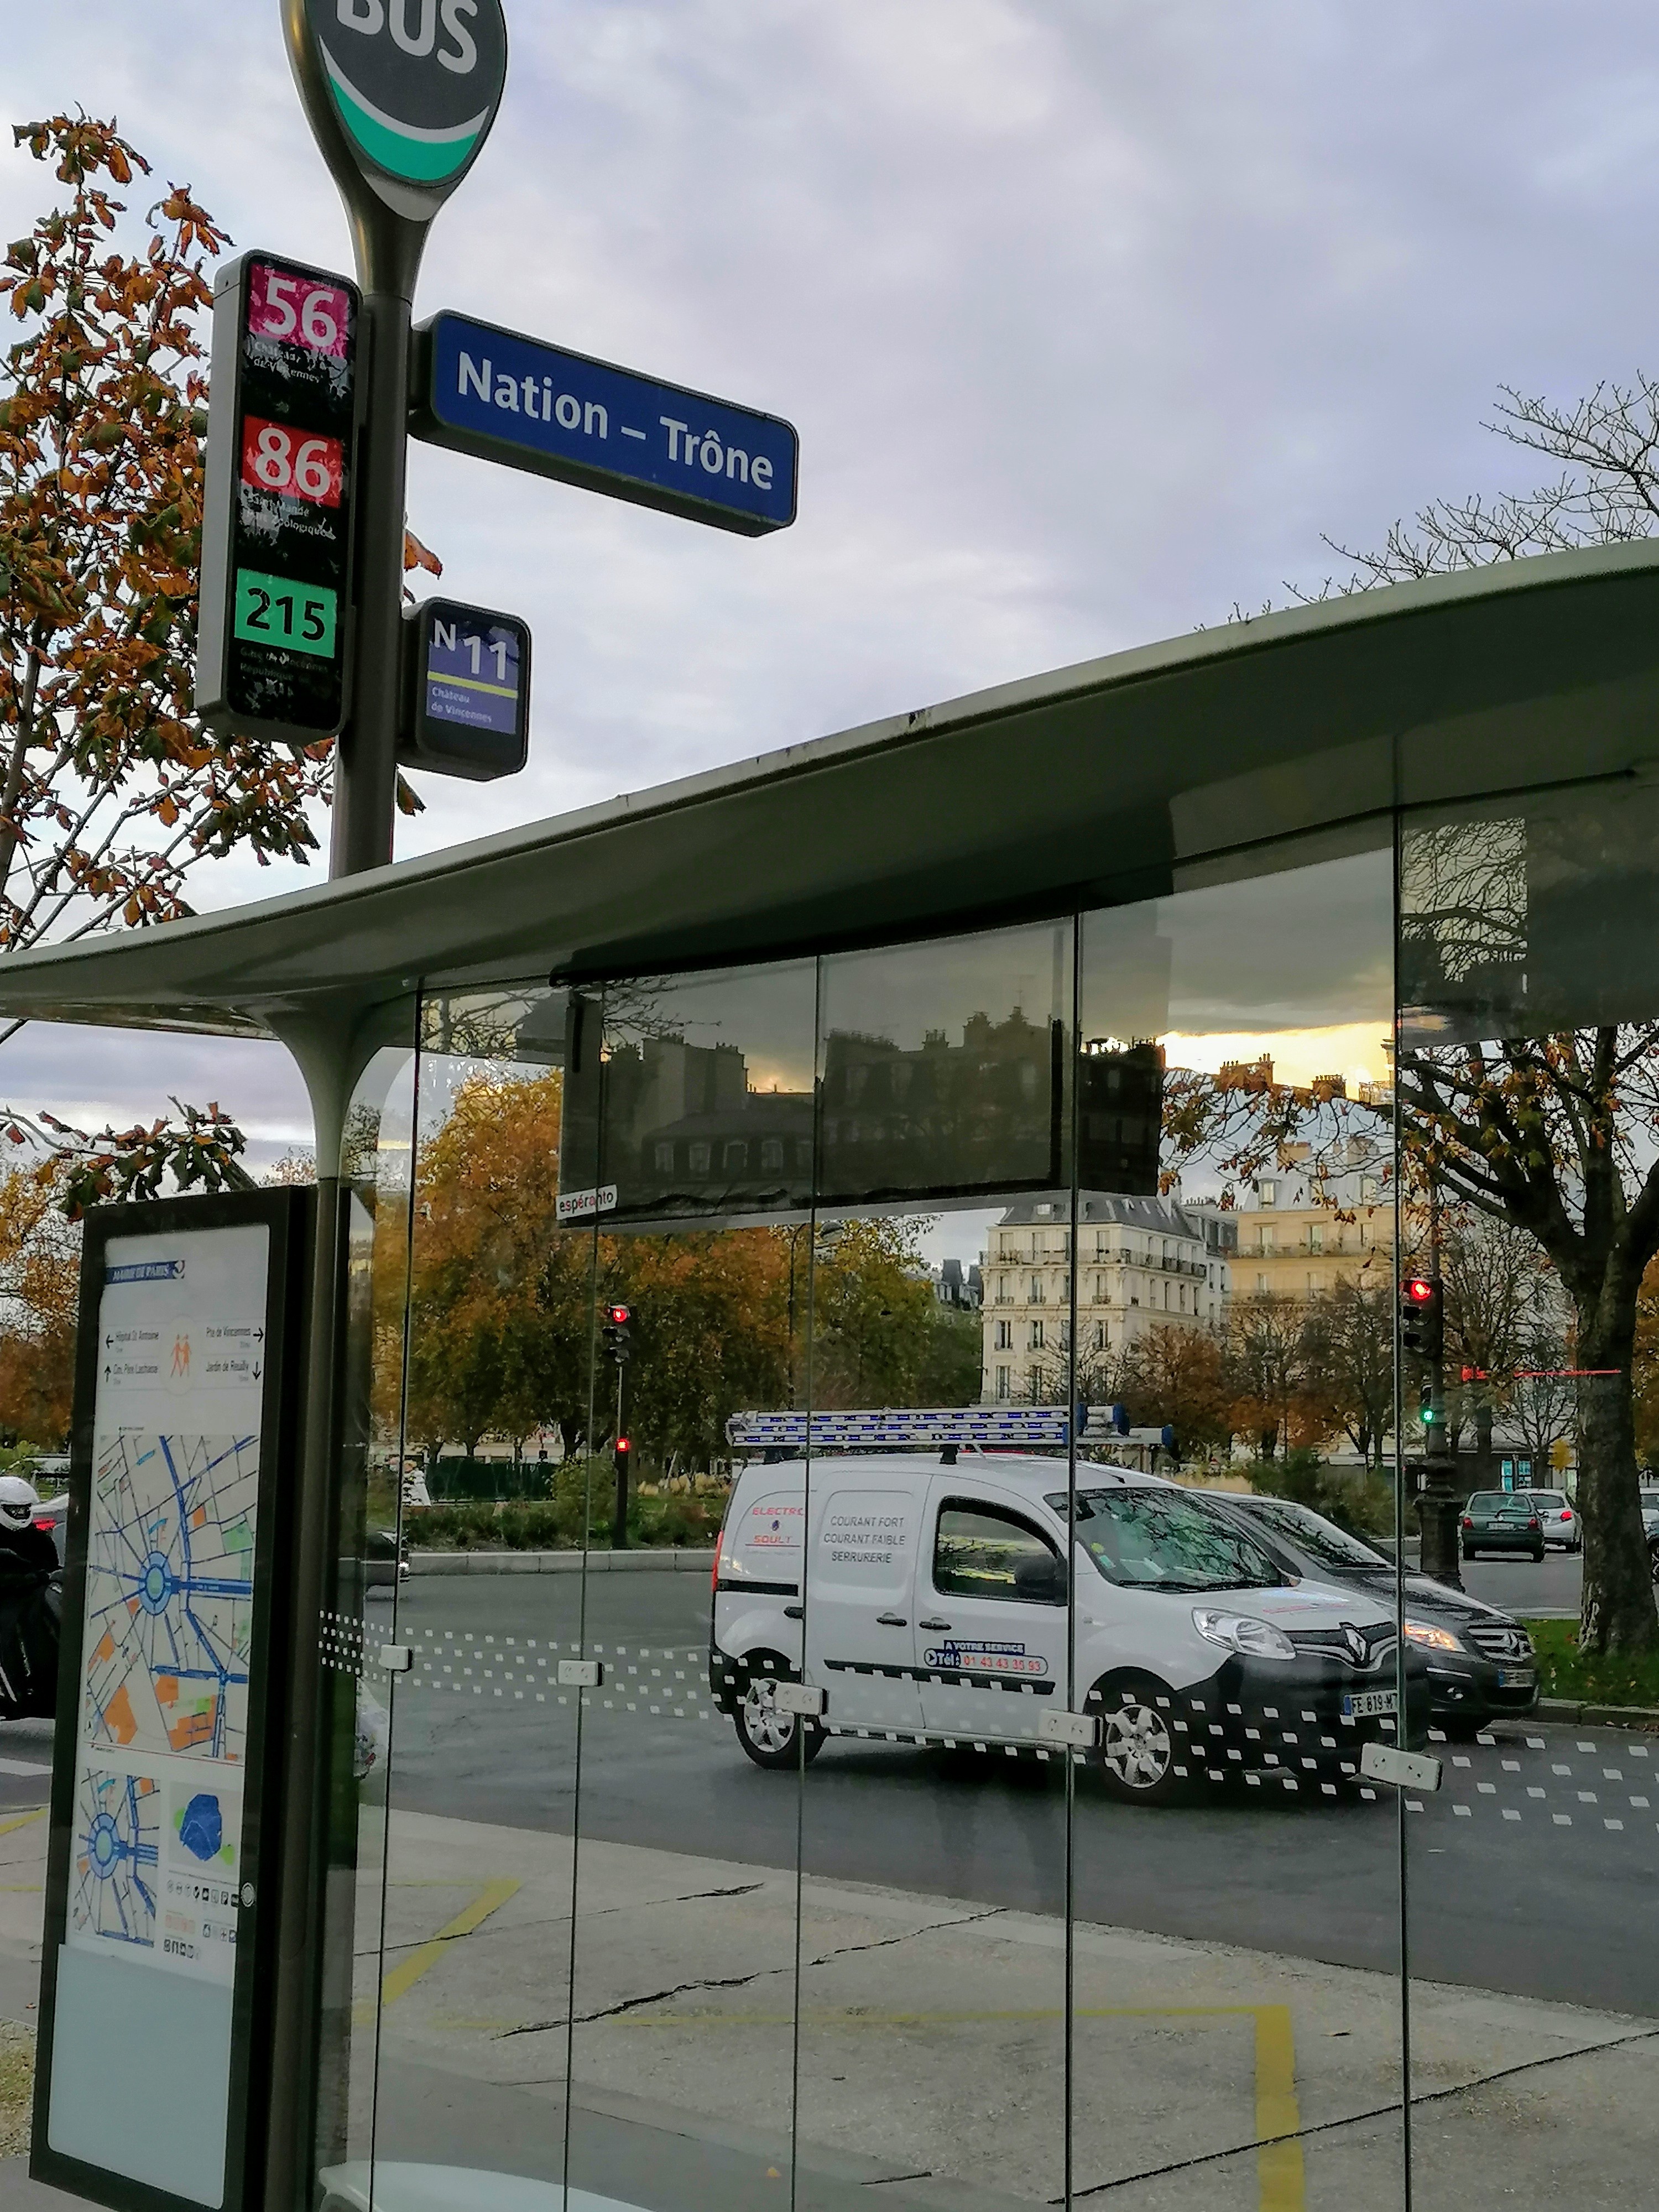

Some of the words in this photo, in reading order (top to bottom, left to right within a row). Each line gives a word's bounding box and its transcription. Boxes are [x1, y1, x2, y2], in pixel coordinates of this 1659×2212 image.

[262, 277, 338, 348] 56
[458, 351, 608, 440] Nation
[660, 416, 773, 491] Trône
[255, 427, 332, 498] 86
[246, 587, 325, 641] 215
[432, 686, 470, 703] Château
[445, 705, 492, 723] Vincennes
[559, 1191, 614, 1214] espéranto
[831, 1516, 877, 1526] COURANT
[878, 1517, 904, 1527] FORT
[754, 1535, 792, 1544] SOULT
[824, 1533, 870, 1543] COURANT
[872, 1534, 906, 1545] FAIBLE
[832, 1551, 893, 1563] SERRURERIE
